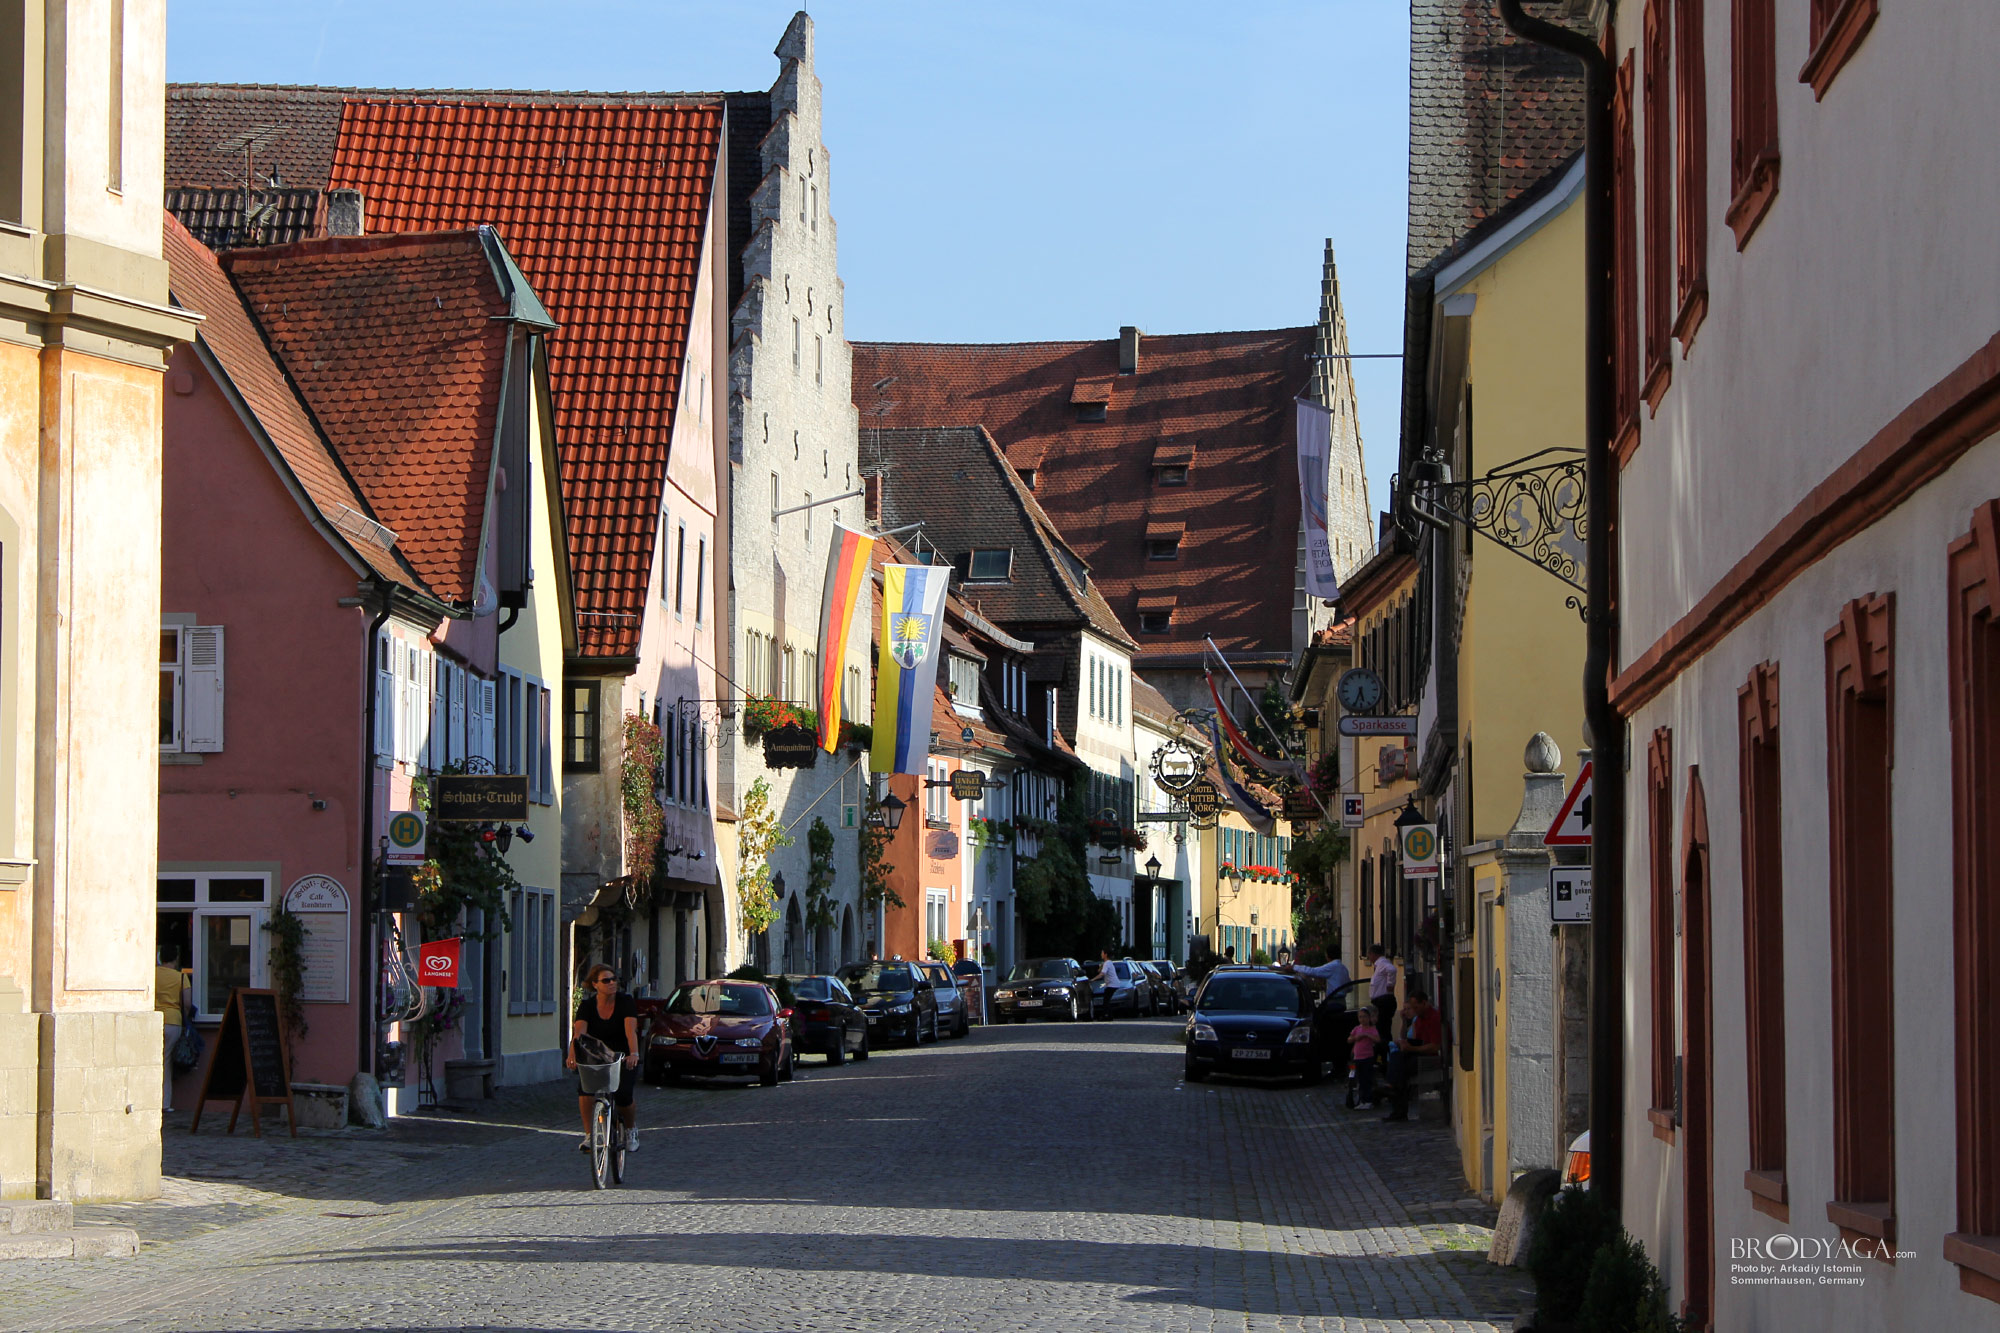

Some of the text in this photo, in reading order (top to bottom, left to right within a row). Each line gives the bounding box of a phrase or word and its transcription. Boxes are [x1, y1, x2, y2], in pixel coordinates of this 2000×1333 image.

[1351, 719, 1408, 731] Sparkasse
[769, 743, 811, 753] Antiquitäten
[442, 791, 524, 806] Schatz-Truhe
[1190, 794, 1216, 803] RITTER
[1194, 802, 1215, 813] JÖRG
[399, 820, 415, 839] H
[1412, 835, 1427, 853] H
[294, 880, 340, 899] Schatz-Truhe
[301, 901, 333, 909] Konditorei
